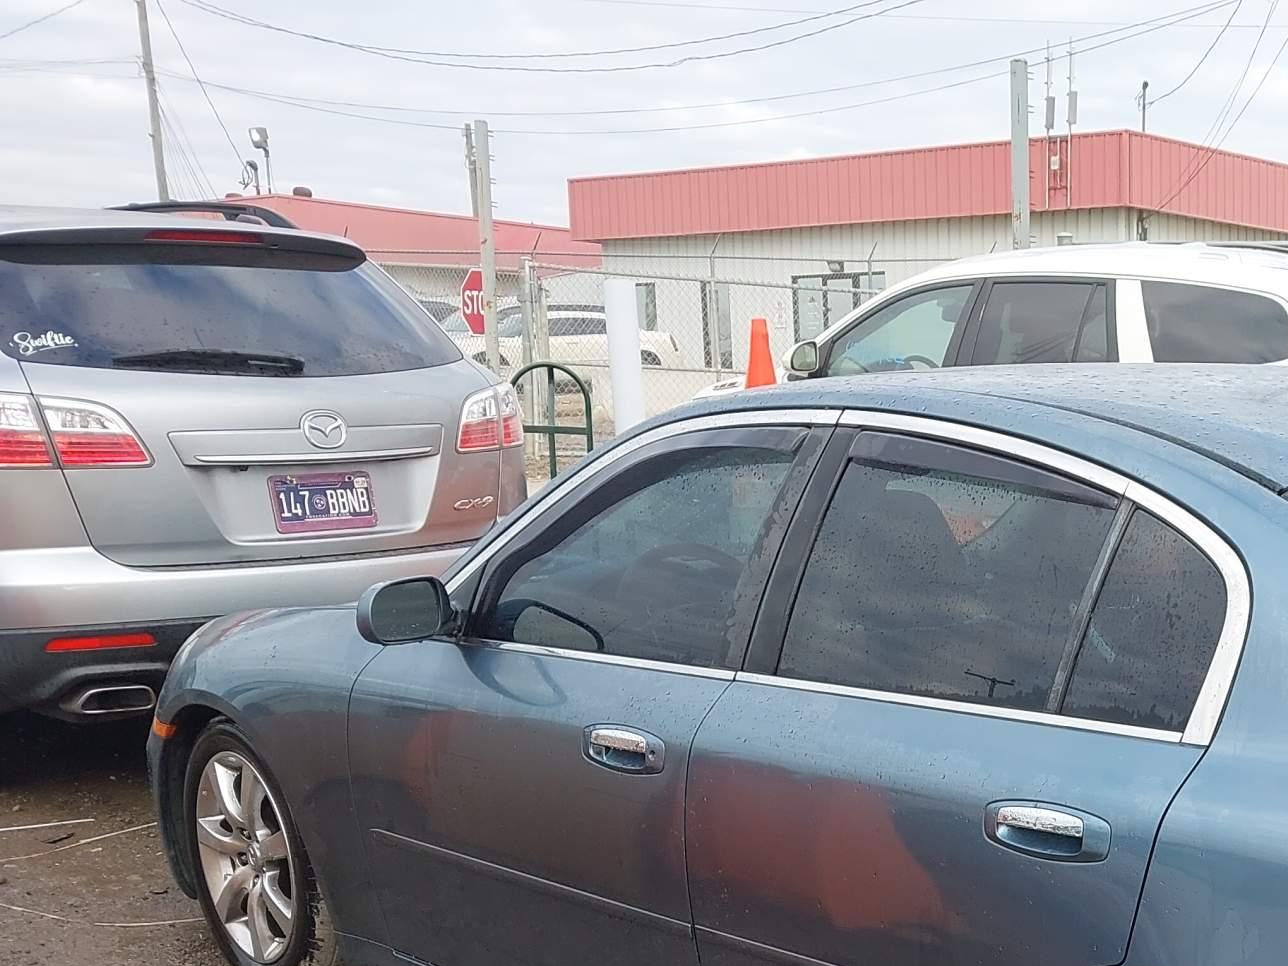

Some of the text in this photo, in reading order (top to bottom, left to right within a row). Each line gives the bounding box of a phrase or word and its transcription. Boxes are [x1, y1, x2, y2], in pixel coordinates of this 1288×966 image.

[464, 290, 485, 315] STO
[13, 331, 75, 355] Swiftie
[280, 488, 370, 517] 147 BBNB
[454, 496, 493, 509] CX-9
